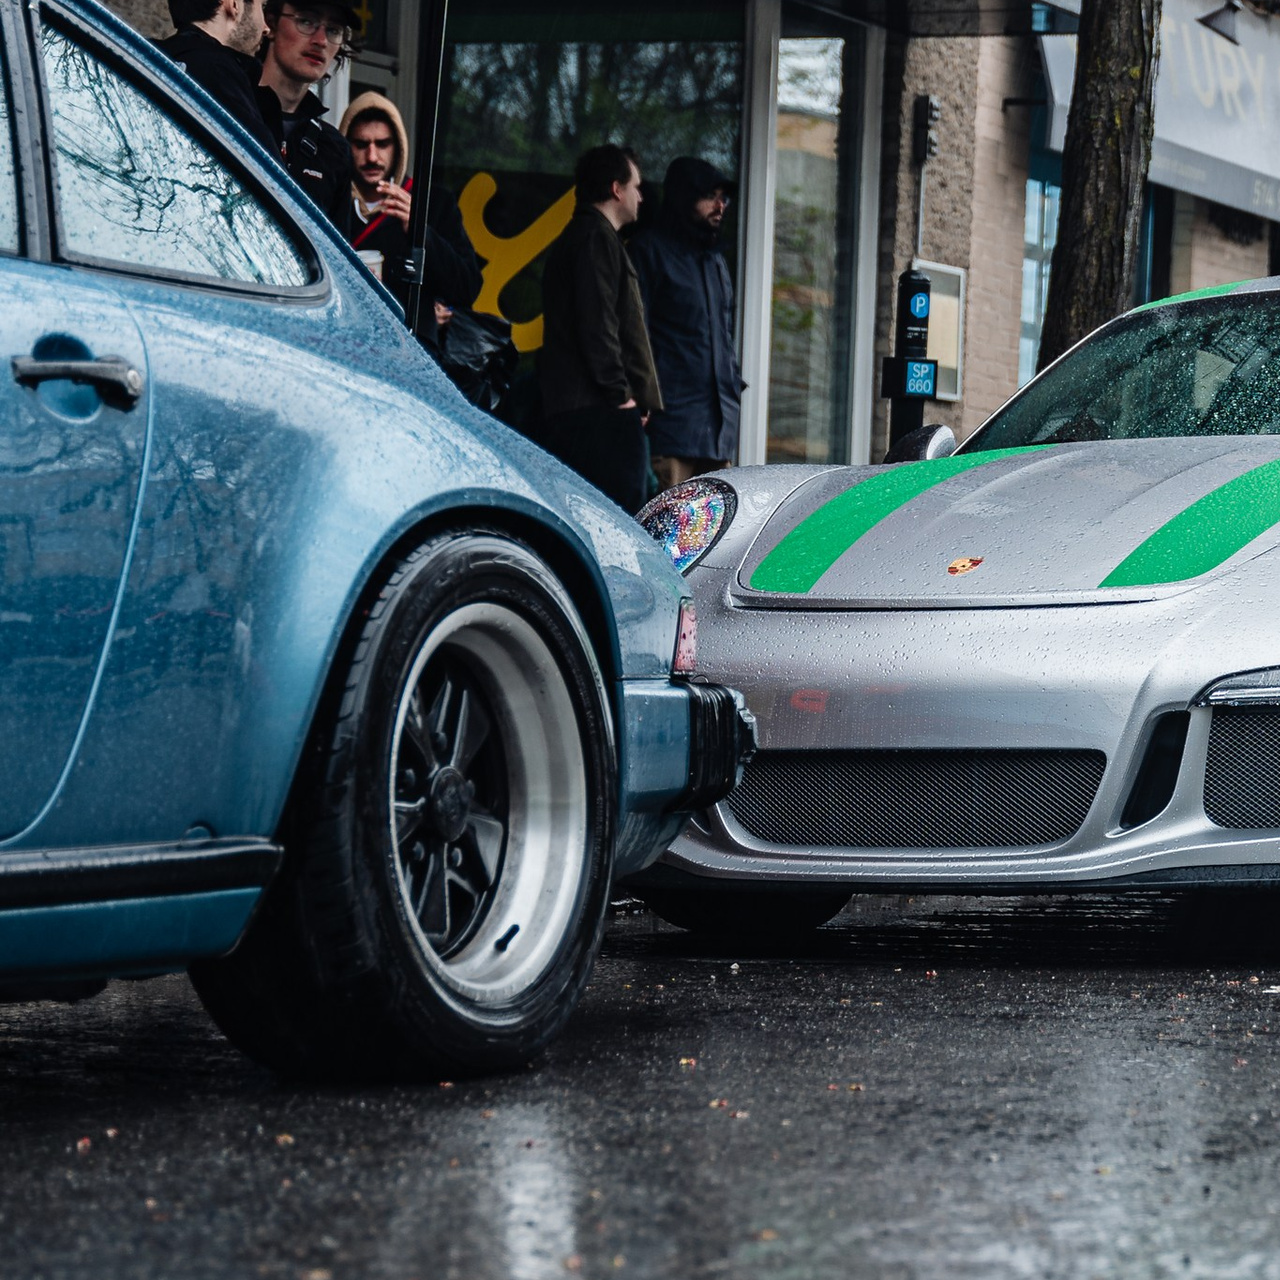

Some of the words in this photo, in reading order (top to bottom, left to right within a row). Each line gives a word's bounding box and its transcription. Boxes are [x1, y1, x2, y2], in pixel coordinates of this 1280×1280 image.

[1161, 16, 1266, 128] TURY
[916, 297, 925, 312] P
[912, 363, 929, 378] SP
[908, 380, 931, 393] 660
